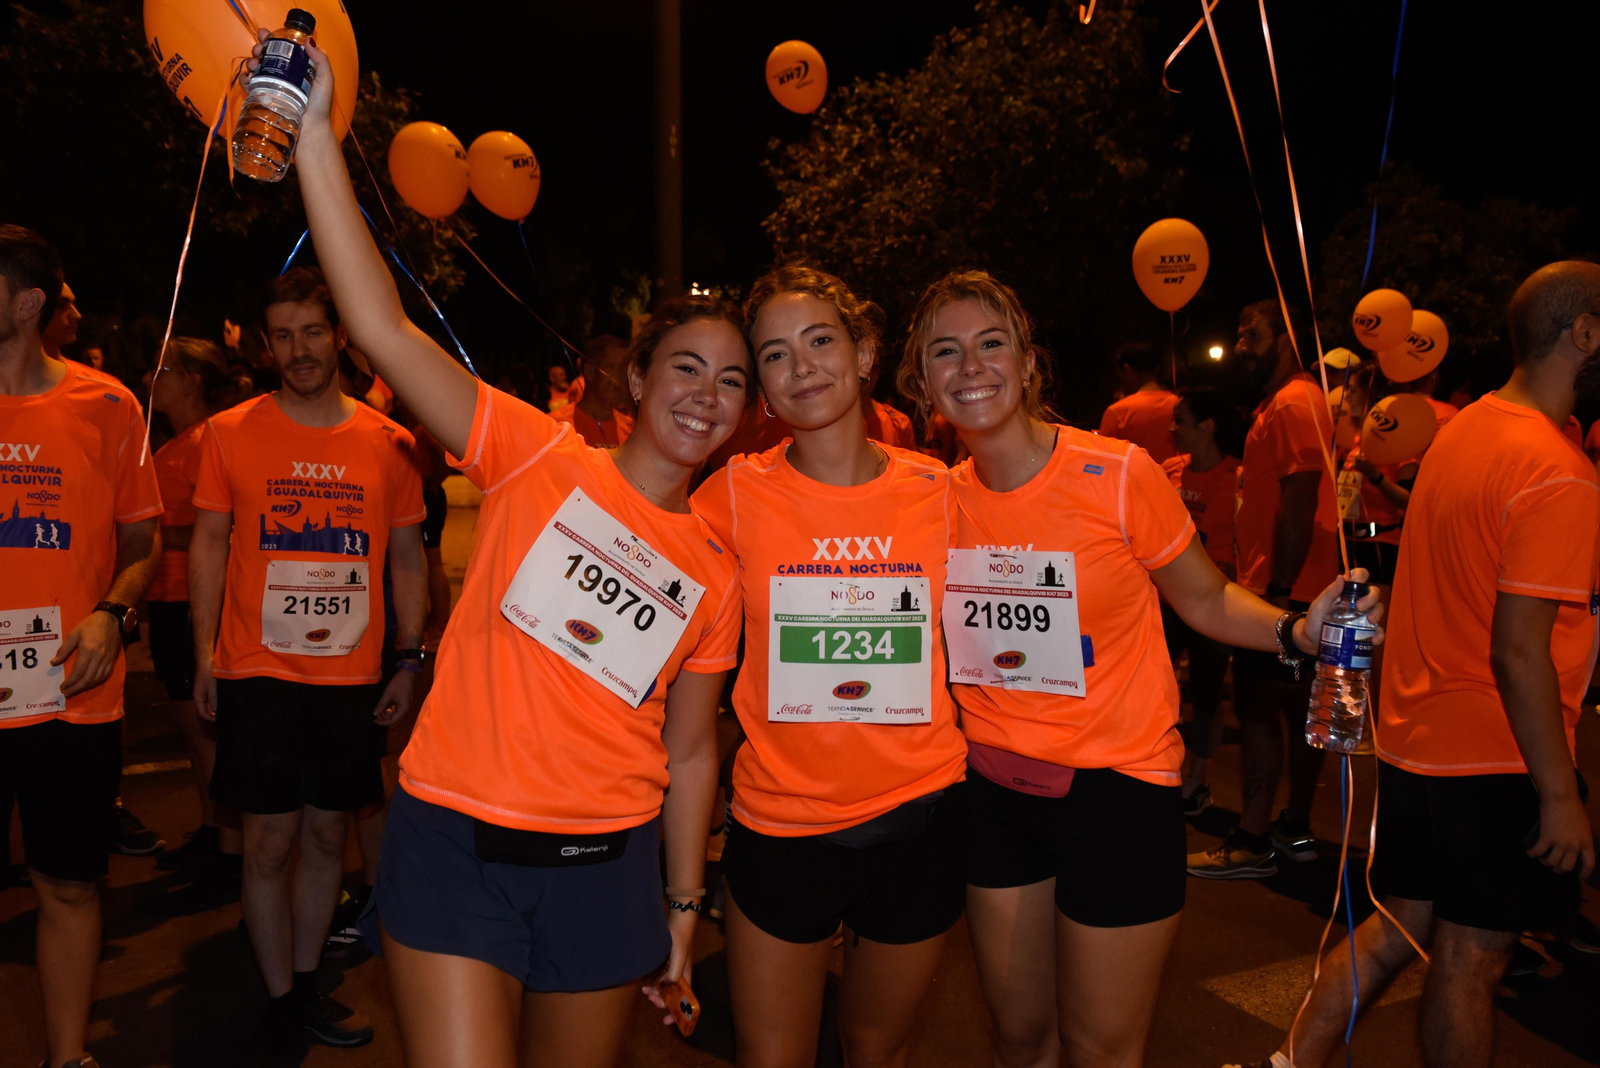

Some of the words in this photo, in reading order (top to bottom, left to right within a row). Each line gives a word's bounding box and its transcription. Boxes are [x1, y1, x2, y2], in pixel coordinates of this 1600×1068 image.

[1160, 254, 1191, 264] XXXV
[291, 461, 346, 480] XXXV
[0, 474, 62, 487] LQUIVIR
[267, 479, 311, 487] CARRERA
[315, 481, 364, 492] NOCTURNA
[274, 487, 364, 502] GUADALQUIVIR
[812, 536, 893, 560] XXXV
[557, 524, 572, 536] XXXV
[572, 534, 595, 552] CARRERA
[594, 549, 622, 571] NOCTURNA
[621, 567, 630, 577] DEL
[629, 574, 663, 601] GUADALQUIVIR
[663, 599, 673, 609] KH7
[672, 606, 684, 617] 2023
[777, 564, 843, 574] CARRERA
[850, 563, 923, 574] NOCTURNA
[564, 554, 656, 631] 19970
[283, 596, 350, 615] 21551
[964, 600, 1050, 632] 21899
[812, 630, 895, 660] 1234
[0, 647, 38, 670] 18
[601, 667, 638, 696] Cruzcampo
[1041, 677, 1078, 688] Cruzcampo
[886, 707, 923, 716] Cruzcampo
